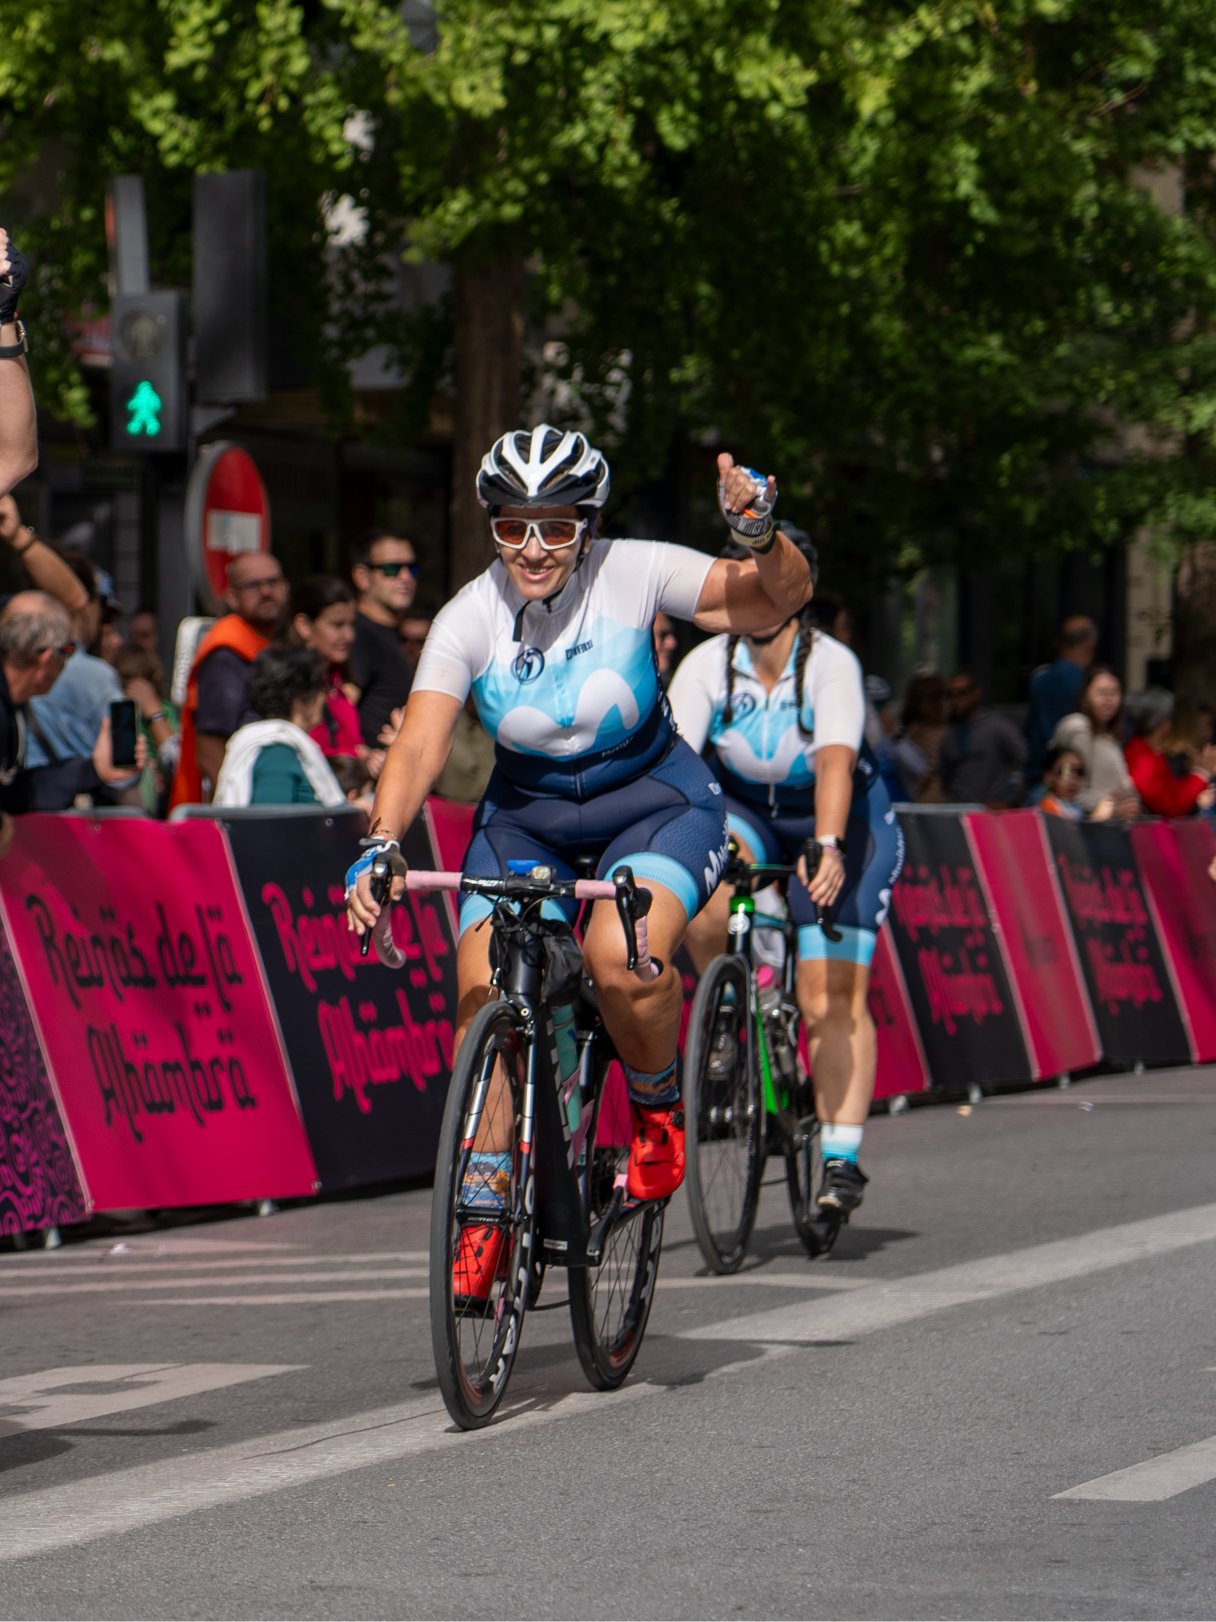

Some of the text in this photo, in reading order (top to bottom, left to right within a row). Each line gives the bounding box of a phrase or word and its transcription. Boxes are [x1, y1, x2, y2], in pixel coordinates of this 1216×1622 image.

[25, 893, 244, 1013] Reinas de la
[86, 1003, 258, 1144] Alhambra
